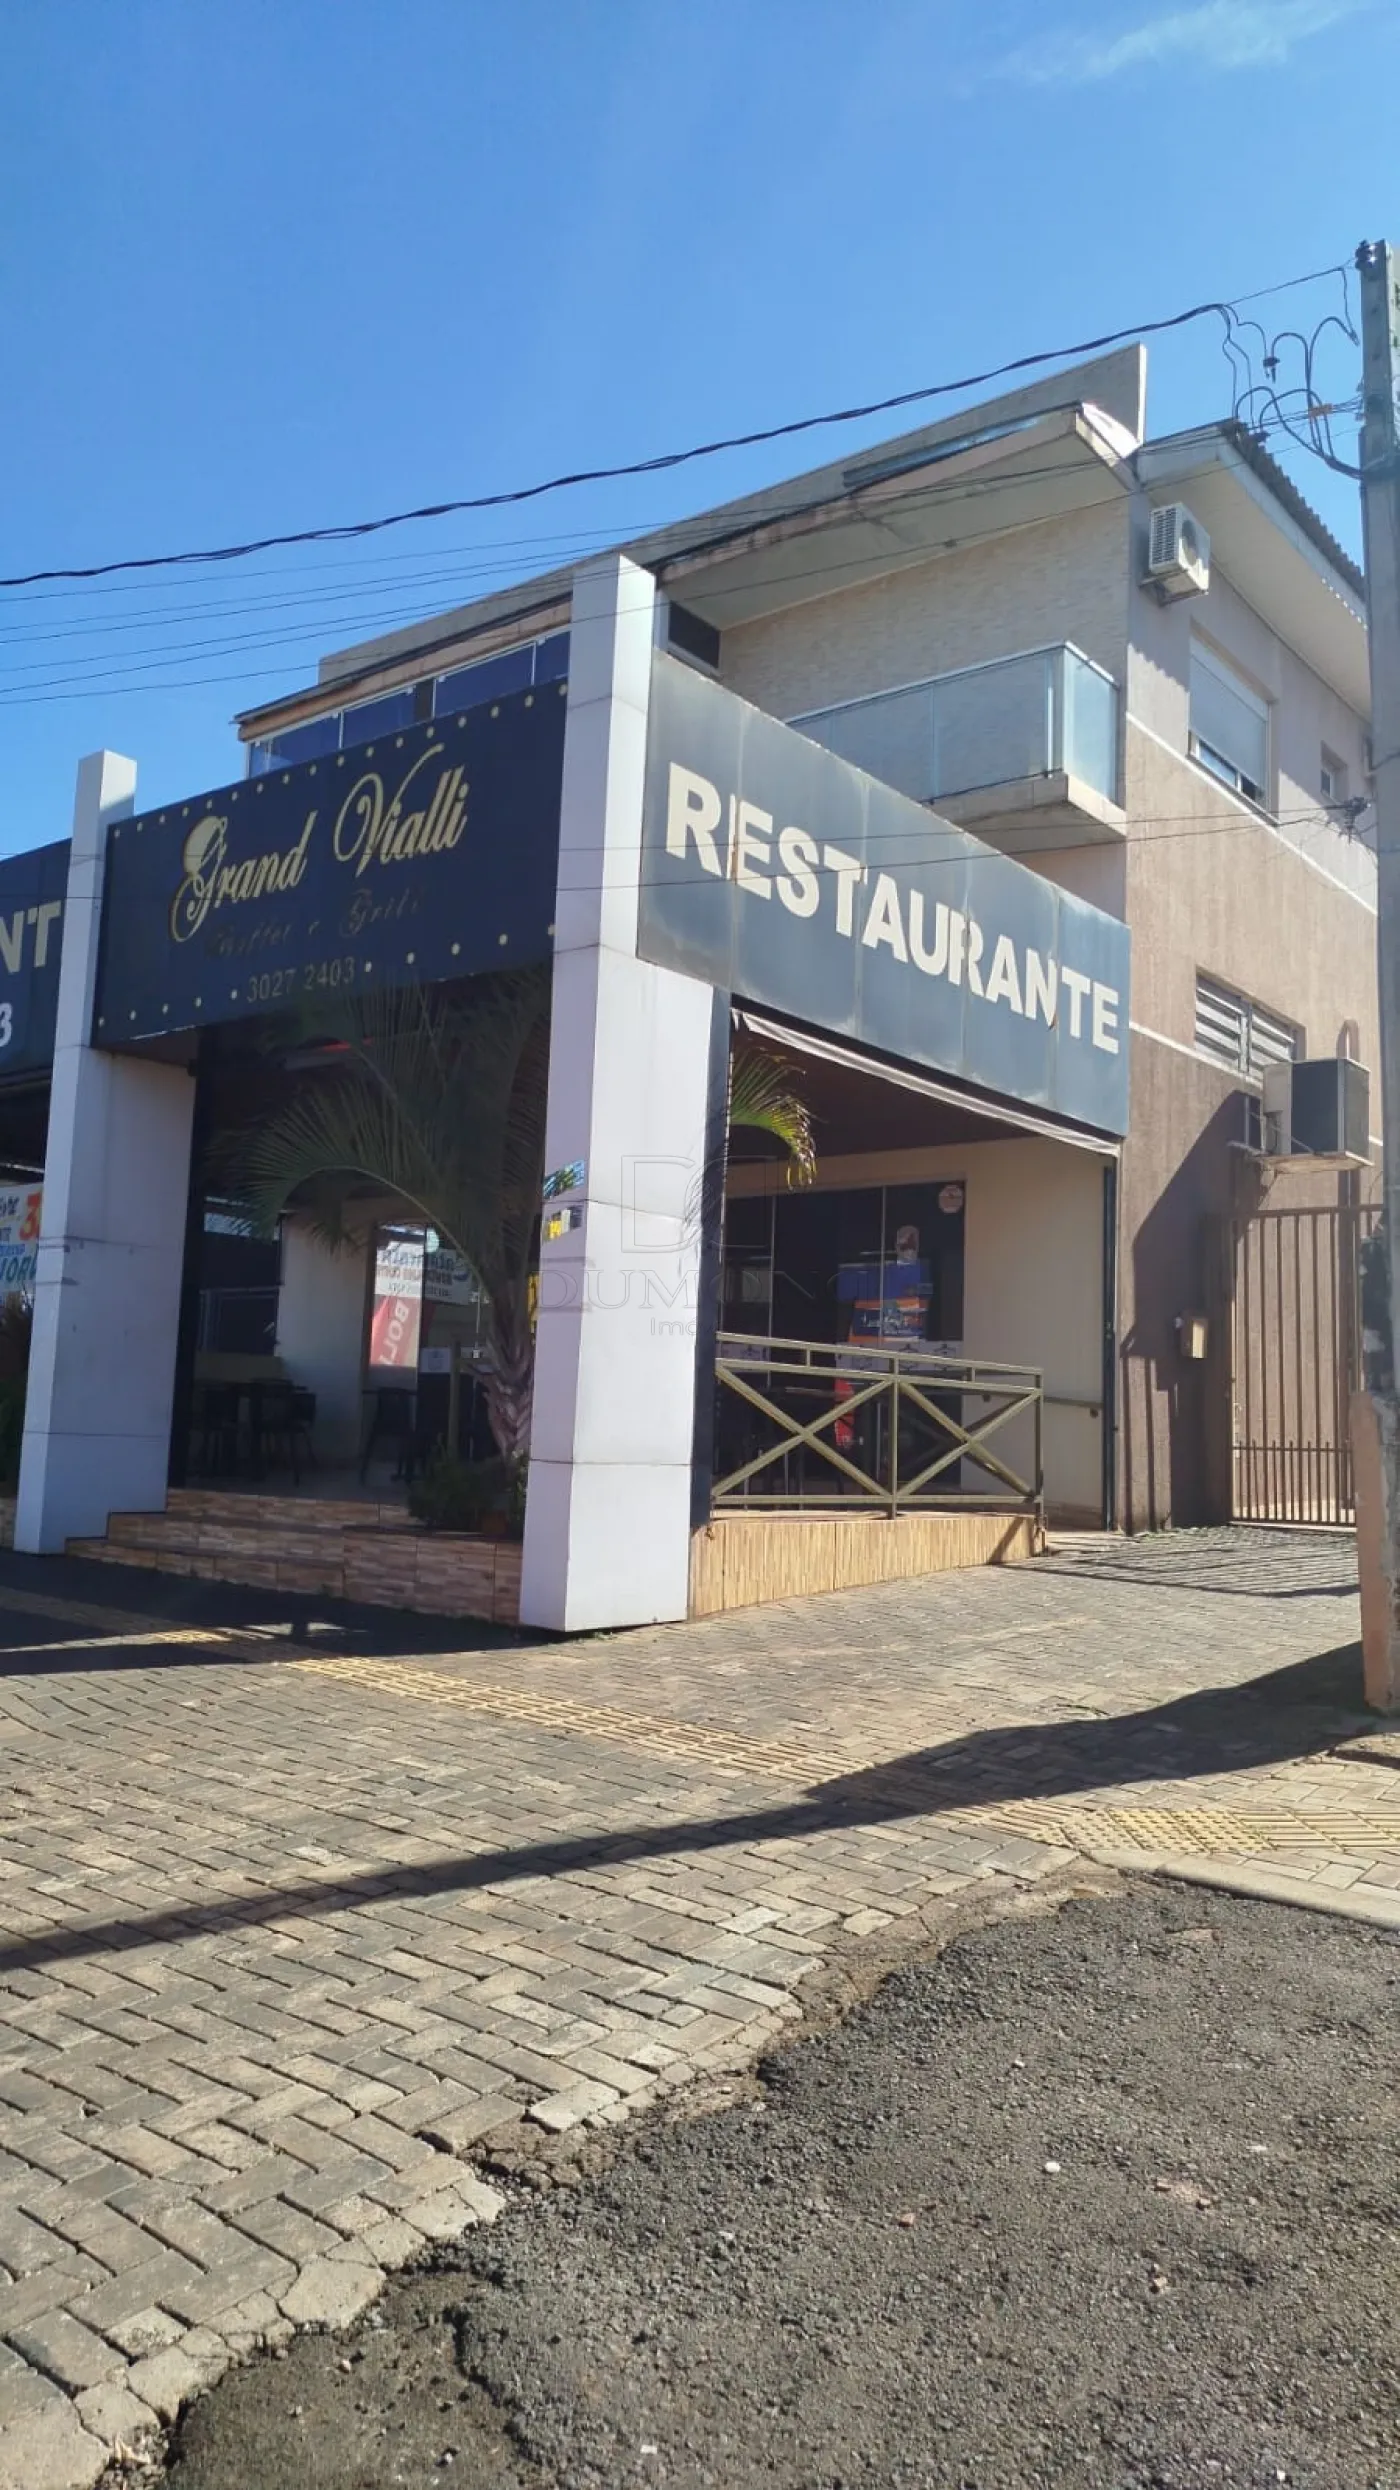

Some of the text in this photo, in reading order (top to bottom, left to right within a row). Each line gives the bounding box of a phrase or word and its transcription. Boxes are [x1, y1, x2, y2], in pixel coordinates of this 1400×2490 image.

[170, 743, 470, 942] Grand Vialli
[666, 761, 1120, 1055] RESTAURANTE
[247, 956, 356, 1004] 3027 2403
